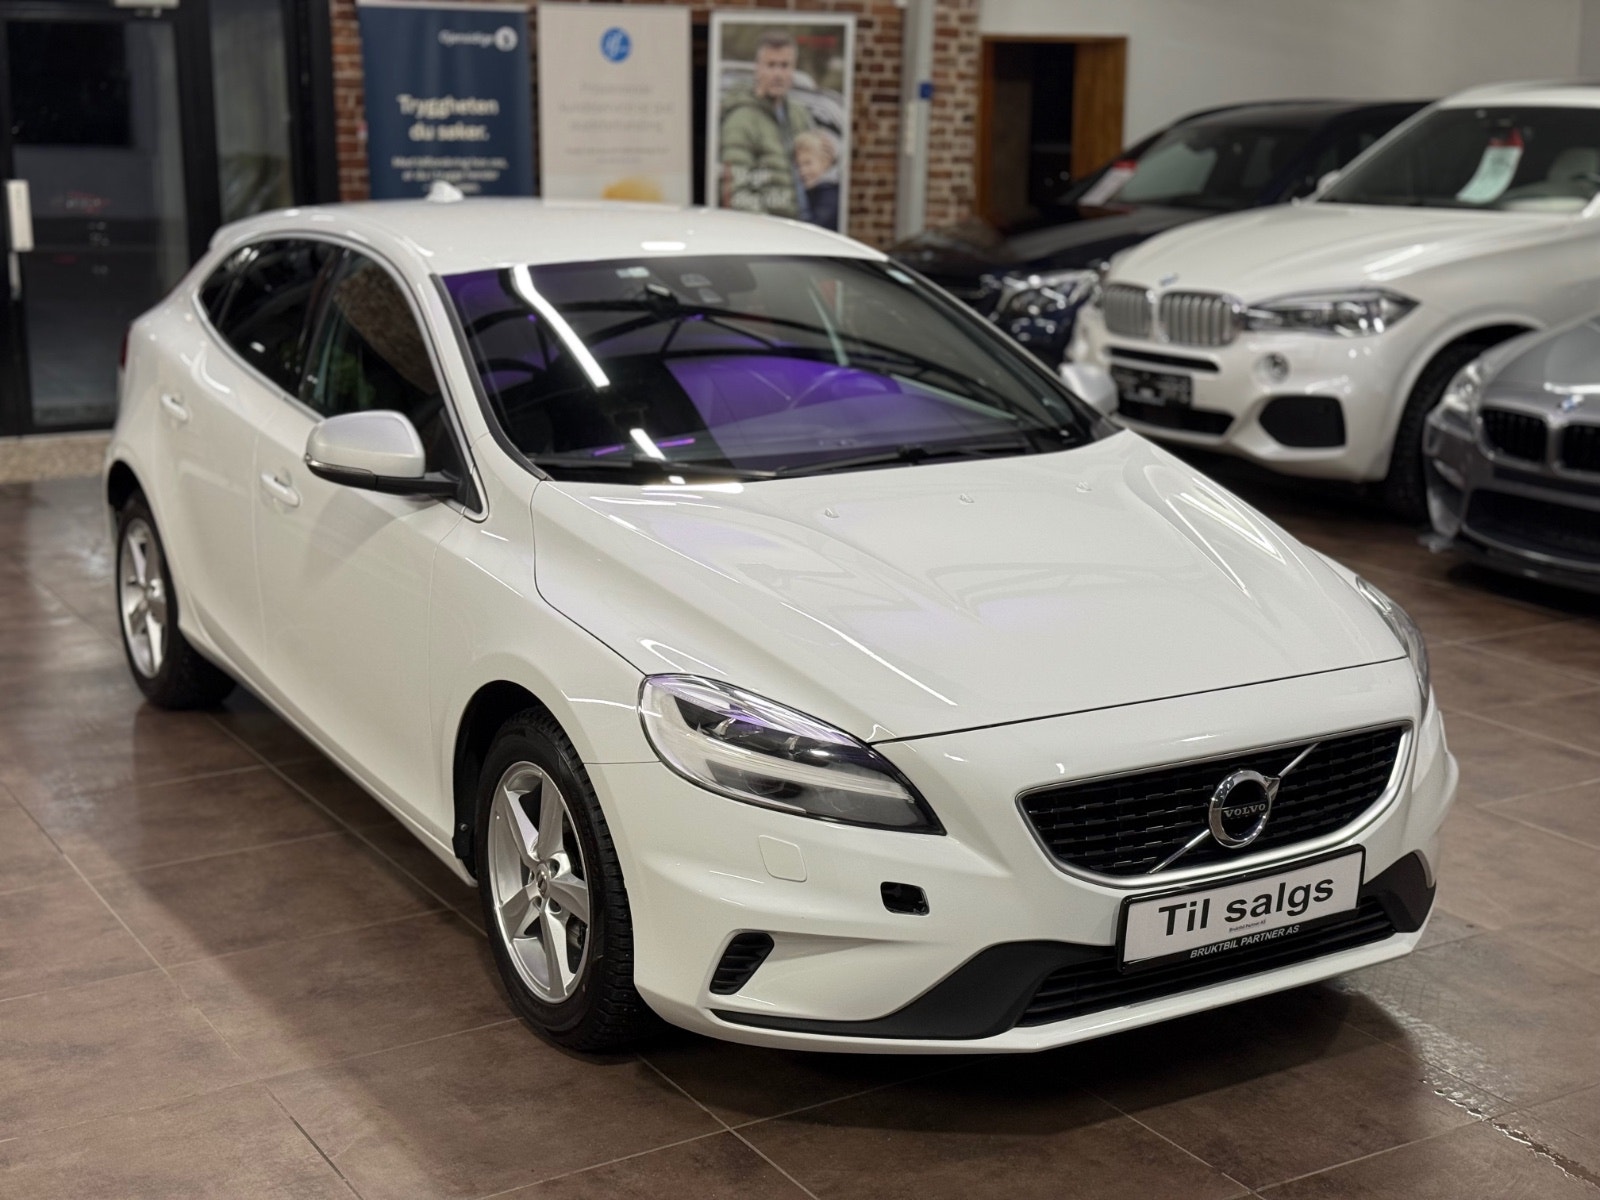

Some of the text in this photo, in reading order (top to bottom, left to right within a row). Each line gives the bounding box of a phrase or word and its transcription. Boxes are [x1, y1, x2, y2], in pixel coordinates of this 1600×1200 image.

[397, 94, 499, 119] Tryggheten
[409, 121, 435, 140] du
[1223, 803, 1266, 818] VOLVO
[1158, 878, 1334, 936] Til salgs
[1190, 924, 1300, 959] BRUKTBIL PARTNER AS
